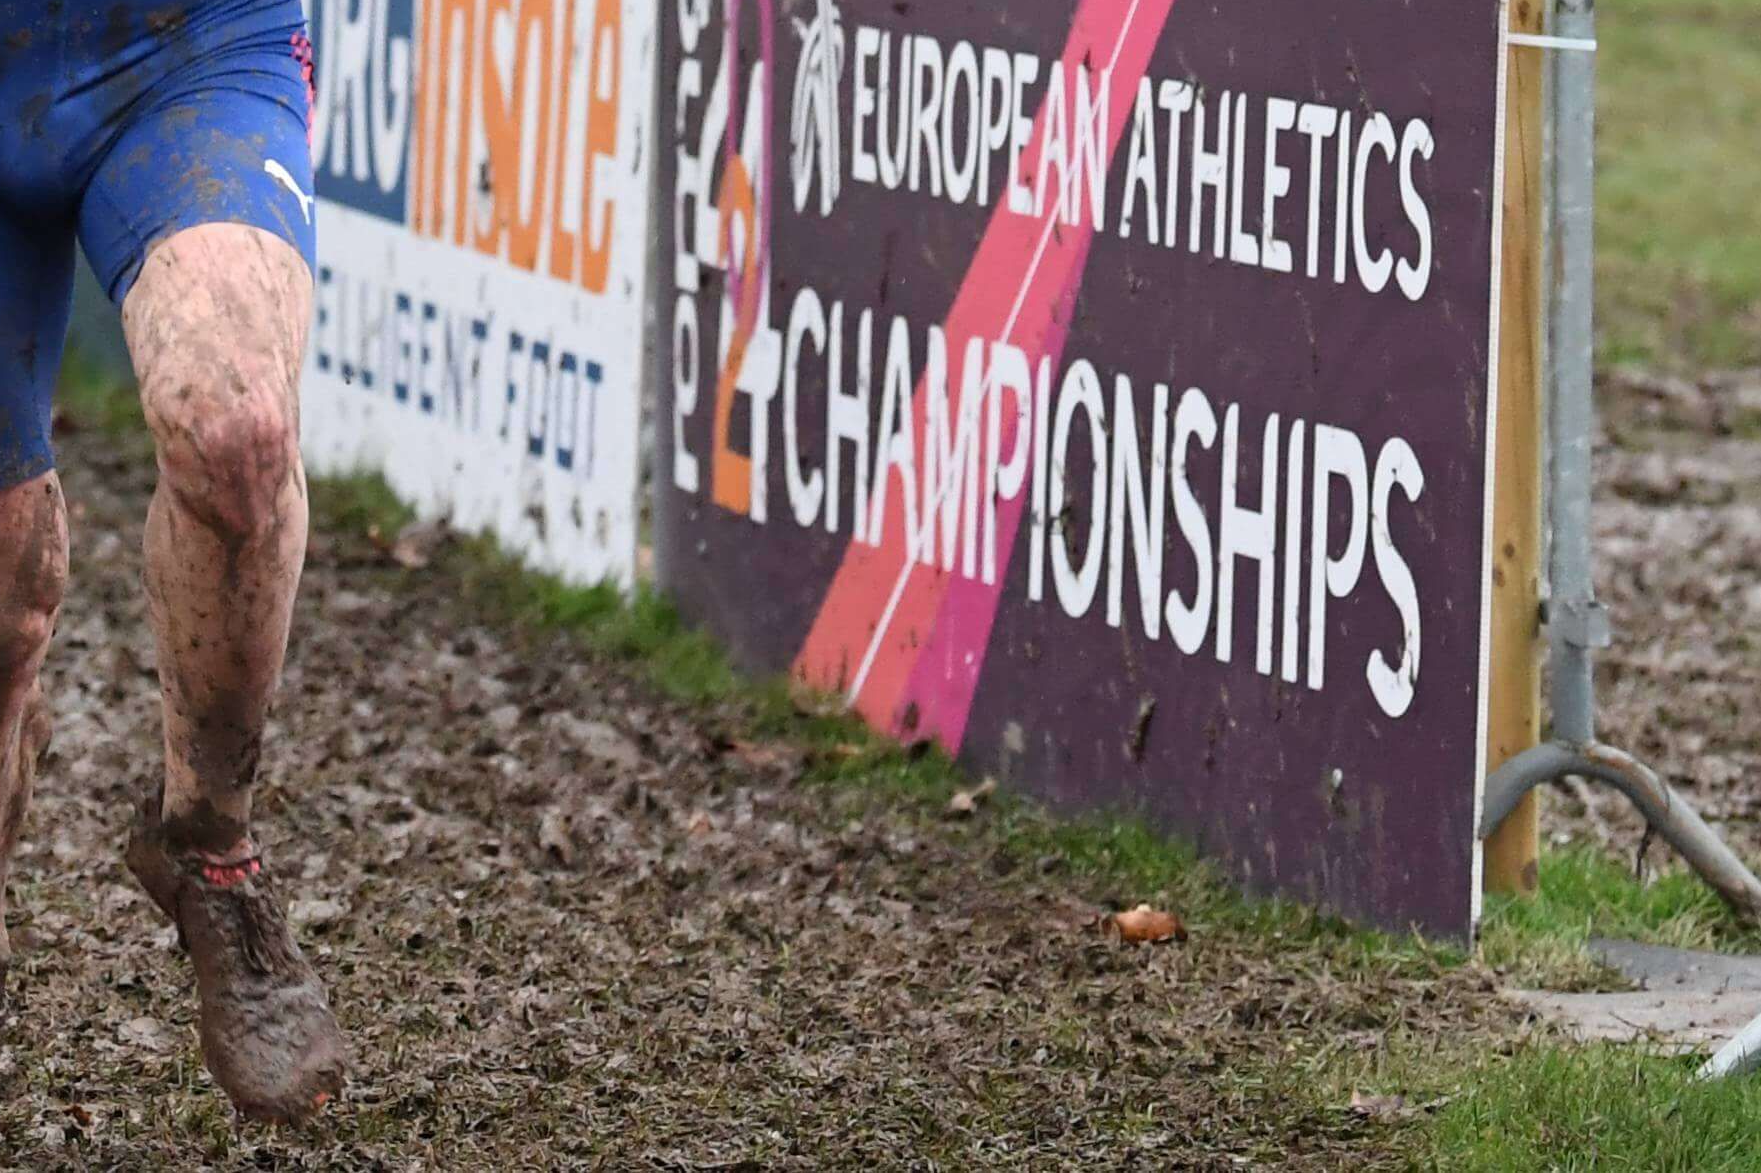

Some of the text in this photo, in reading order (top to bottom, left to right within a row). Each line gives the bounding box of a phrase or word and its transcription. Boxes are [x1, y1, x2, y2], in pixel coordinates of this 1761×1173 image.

[851, 27, 1434, 301] EUROPEAN ATHLETICS
[318, 265, 603, 478] ELLIGENT FOOT
[781, 286, 1424, 719] CHAMPIONSHIPS
